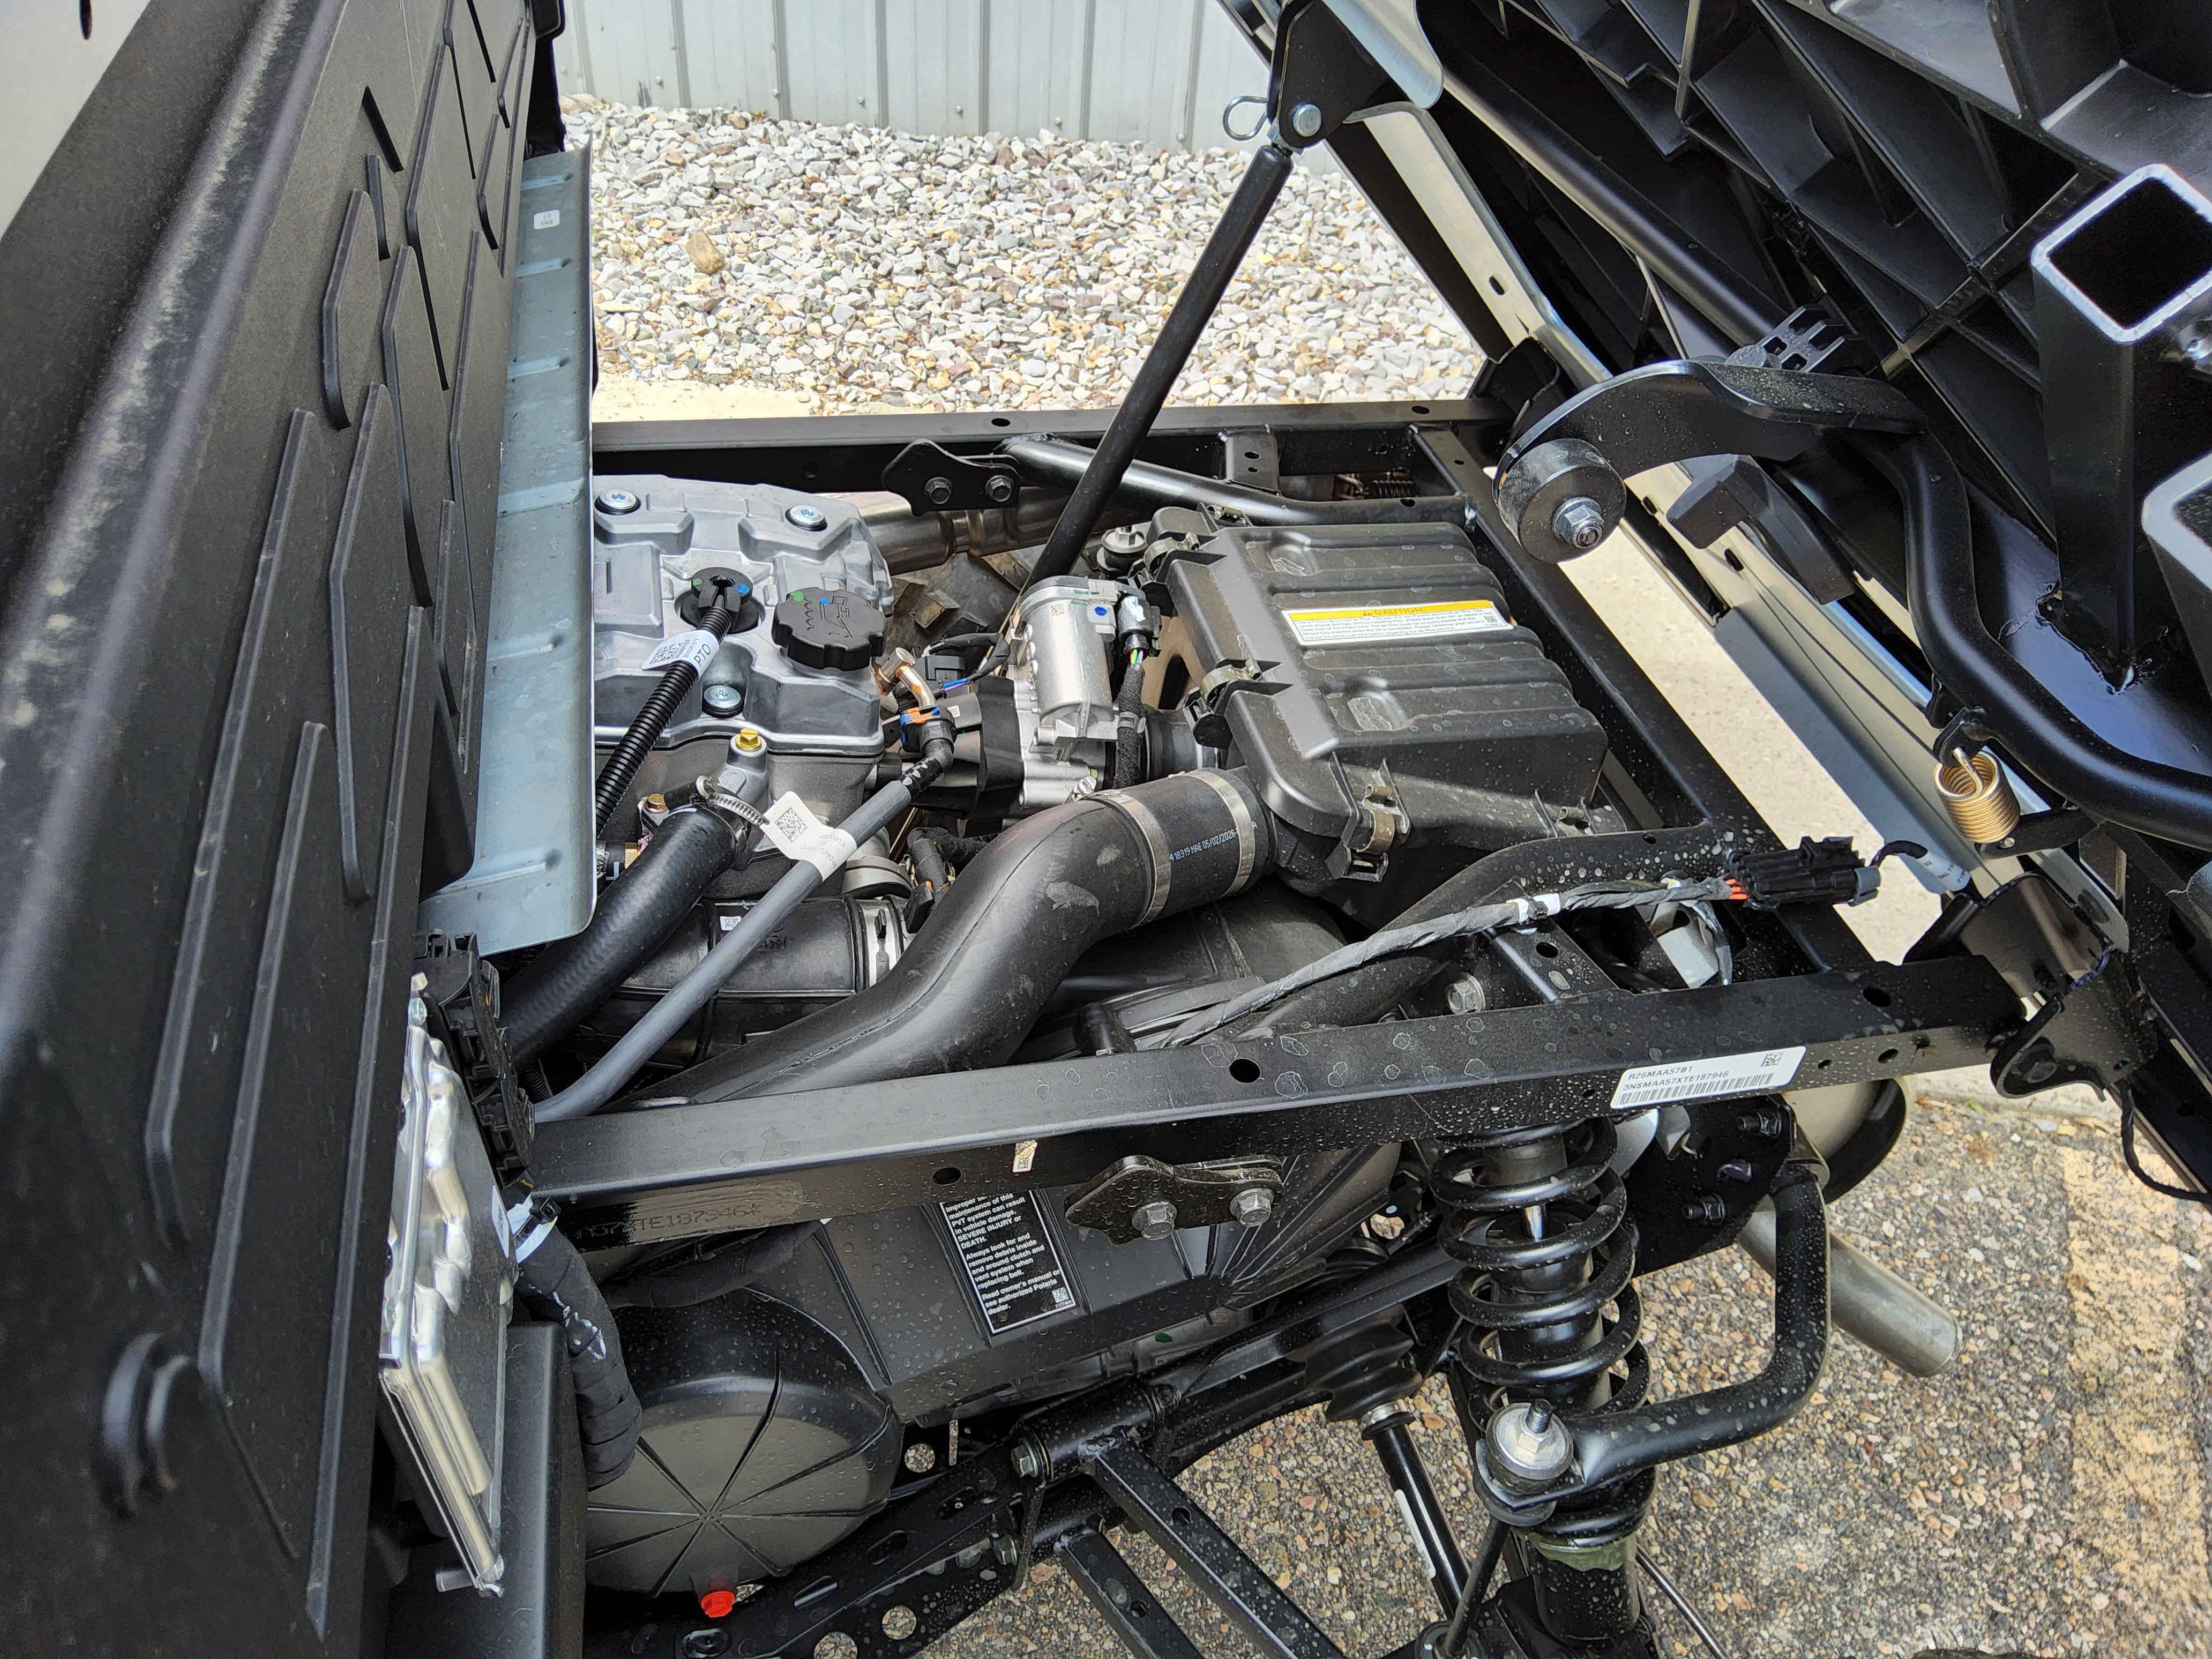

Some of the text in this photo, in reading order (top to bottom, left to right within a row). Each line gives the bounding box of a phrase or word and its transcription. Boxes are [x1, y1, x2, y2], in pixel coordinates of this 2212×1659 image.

[693, 644, 711, 668] PTO
[1190, 842, 1203, 854] MAE
[1202, 827, 1239, 849] 05/02/2026-
[1622, 1070, 1729, 1092] 3NSMAA57XTE187946
[1627, 1065, 1693, 1081] R26MAA57B1
[946, 1198, 975, 1212] Improper
[949, 1202, 991, 1220] maintenance
[1000, 1193, 1013, 1201] this
[952, 1217, 965, 1227] PVT
[967, 1210, 991, 1222] system
[1006, 1197, 1025, 1208] result
[958, 1227, 987, 1241] SEVERE
[987, 1218, 1012, 1231] INJURY
[963, 1220, 987, 1231] vehicle
[961, 1236, 987, 1249] DEATH.
[967, 1249, 990, 1260] Always
[990, 1242, 1006, 1251] look
[1018, 1232, 1030, 1242] and
[969, 1240, 1037, 1267] remove debris inside
[972, 1244, 1044, 1275] and around clutch and
[975, 1258, 1034, 1282] vent system when
[978, 1269, 1024, 1289] replacing belt.
[982, 1290, 999, 1301] Read
[1000, 1281, 1027, 1294] owner's
[1027, 1272, 1052, 1284] manual
[998, 1287, 1033, 1303] authorized
[1033, 1279, 1057, 1290] Polaris
